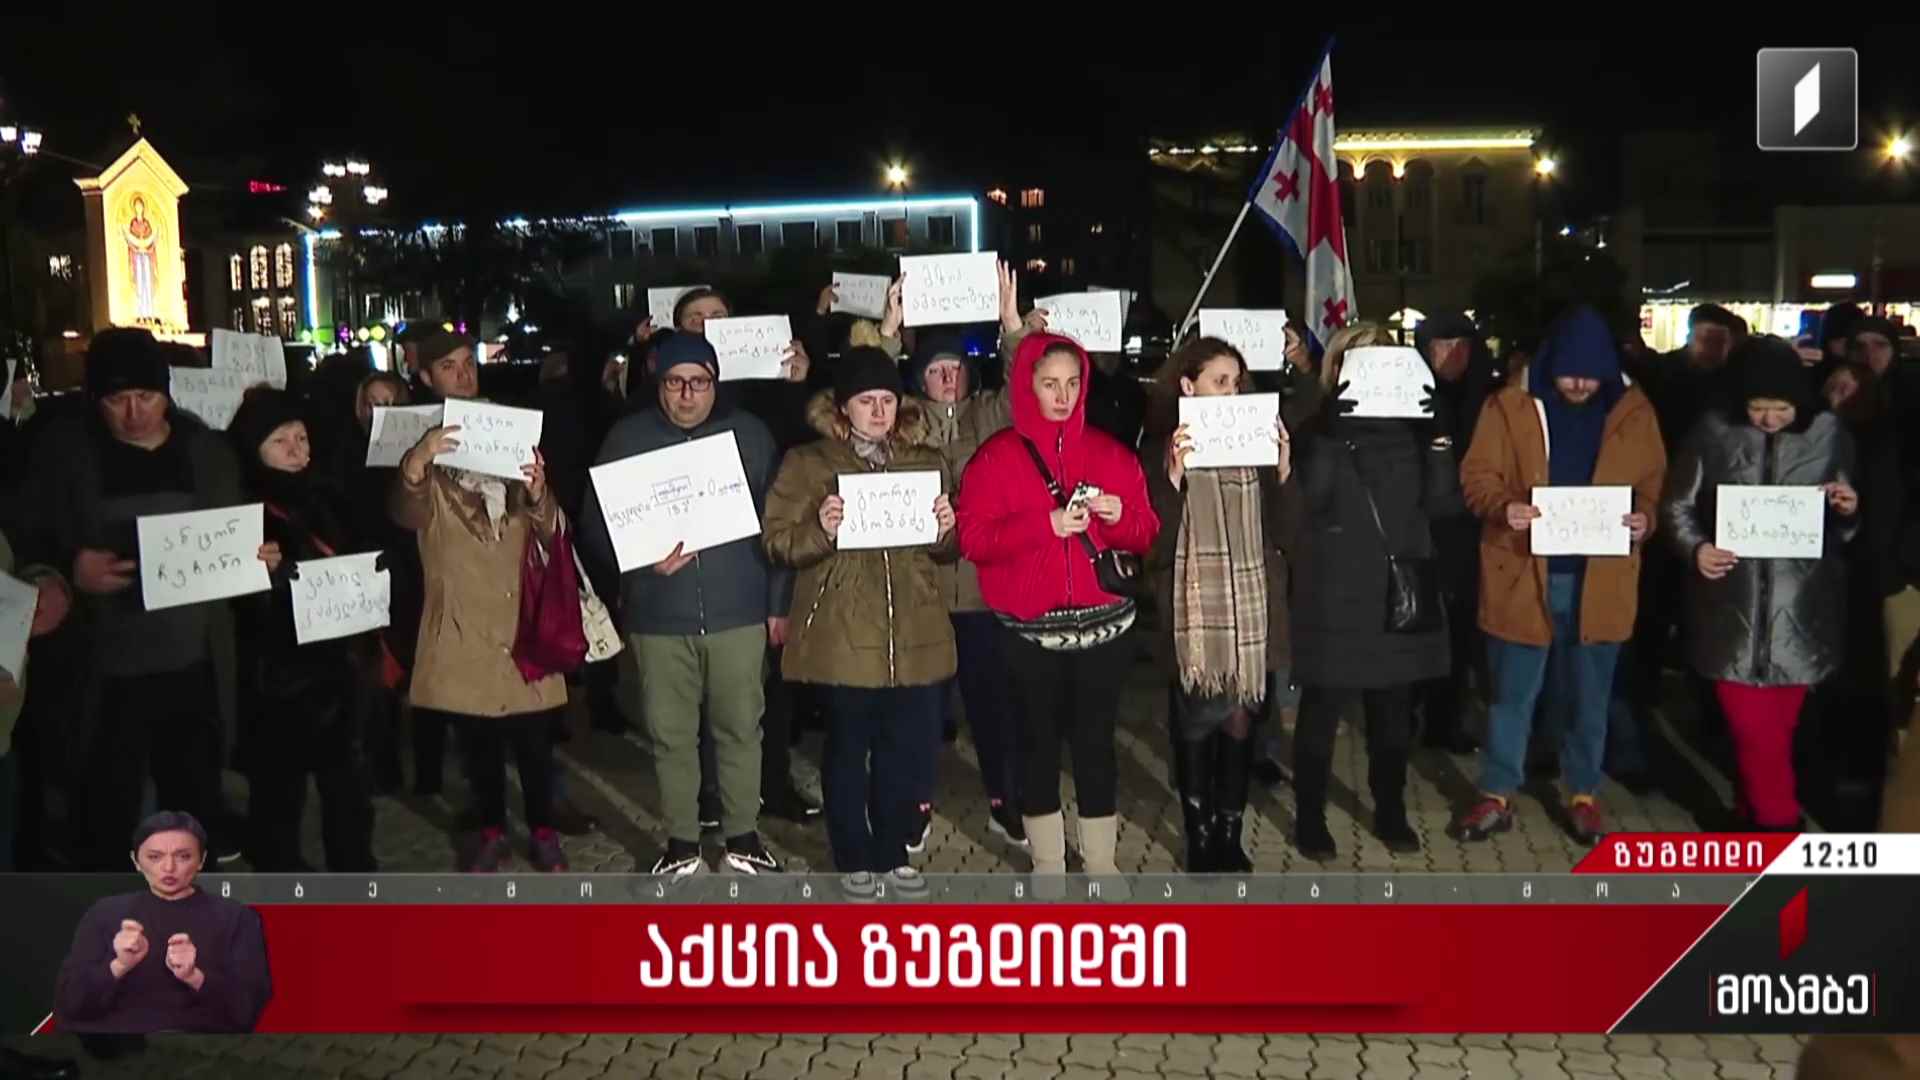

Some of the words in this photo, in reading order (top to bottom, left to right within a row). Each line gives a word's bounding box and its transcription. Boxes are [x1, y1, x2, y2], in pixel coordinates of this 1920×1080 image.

[857, 482, 918, 513] გიორგი
[1739, 494, 1807, 521] გიორგი
[163, 517, 241, 551] ანტონ
[157, 553, 242, 589] ჩეჩინი
